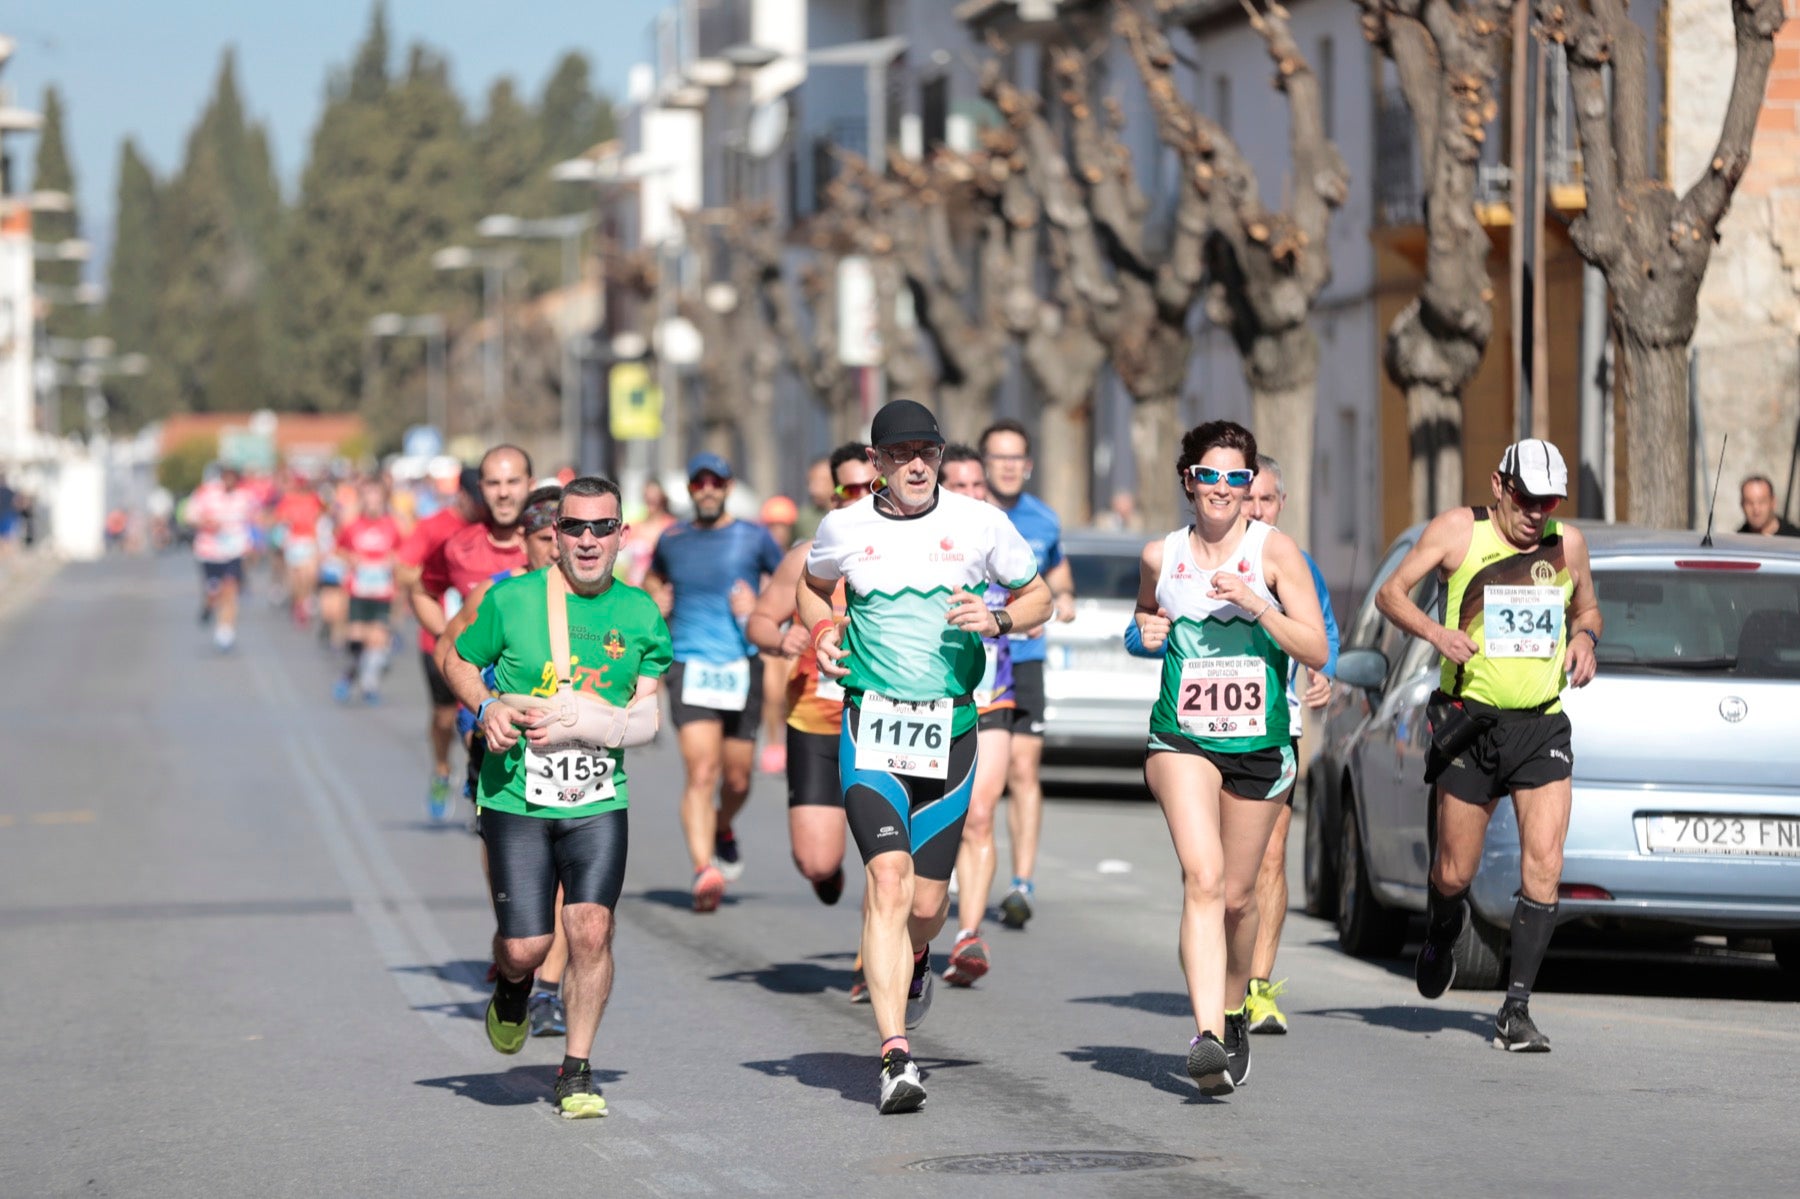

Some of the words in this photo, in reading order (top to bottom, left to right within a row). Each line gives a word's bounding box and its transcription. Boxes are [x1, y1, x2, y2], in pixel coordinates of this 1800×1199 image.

[1499, 609, 1553, 633] 334
[1183, 682, 1261, 711] 2103
[870, 718, 942, 749] 1176
[540, 756, 608, 781] 3155
[1674, 815, 1746, 845] 7023
